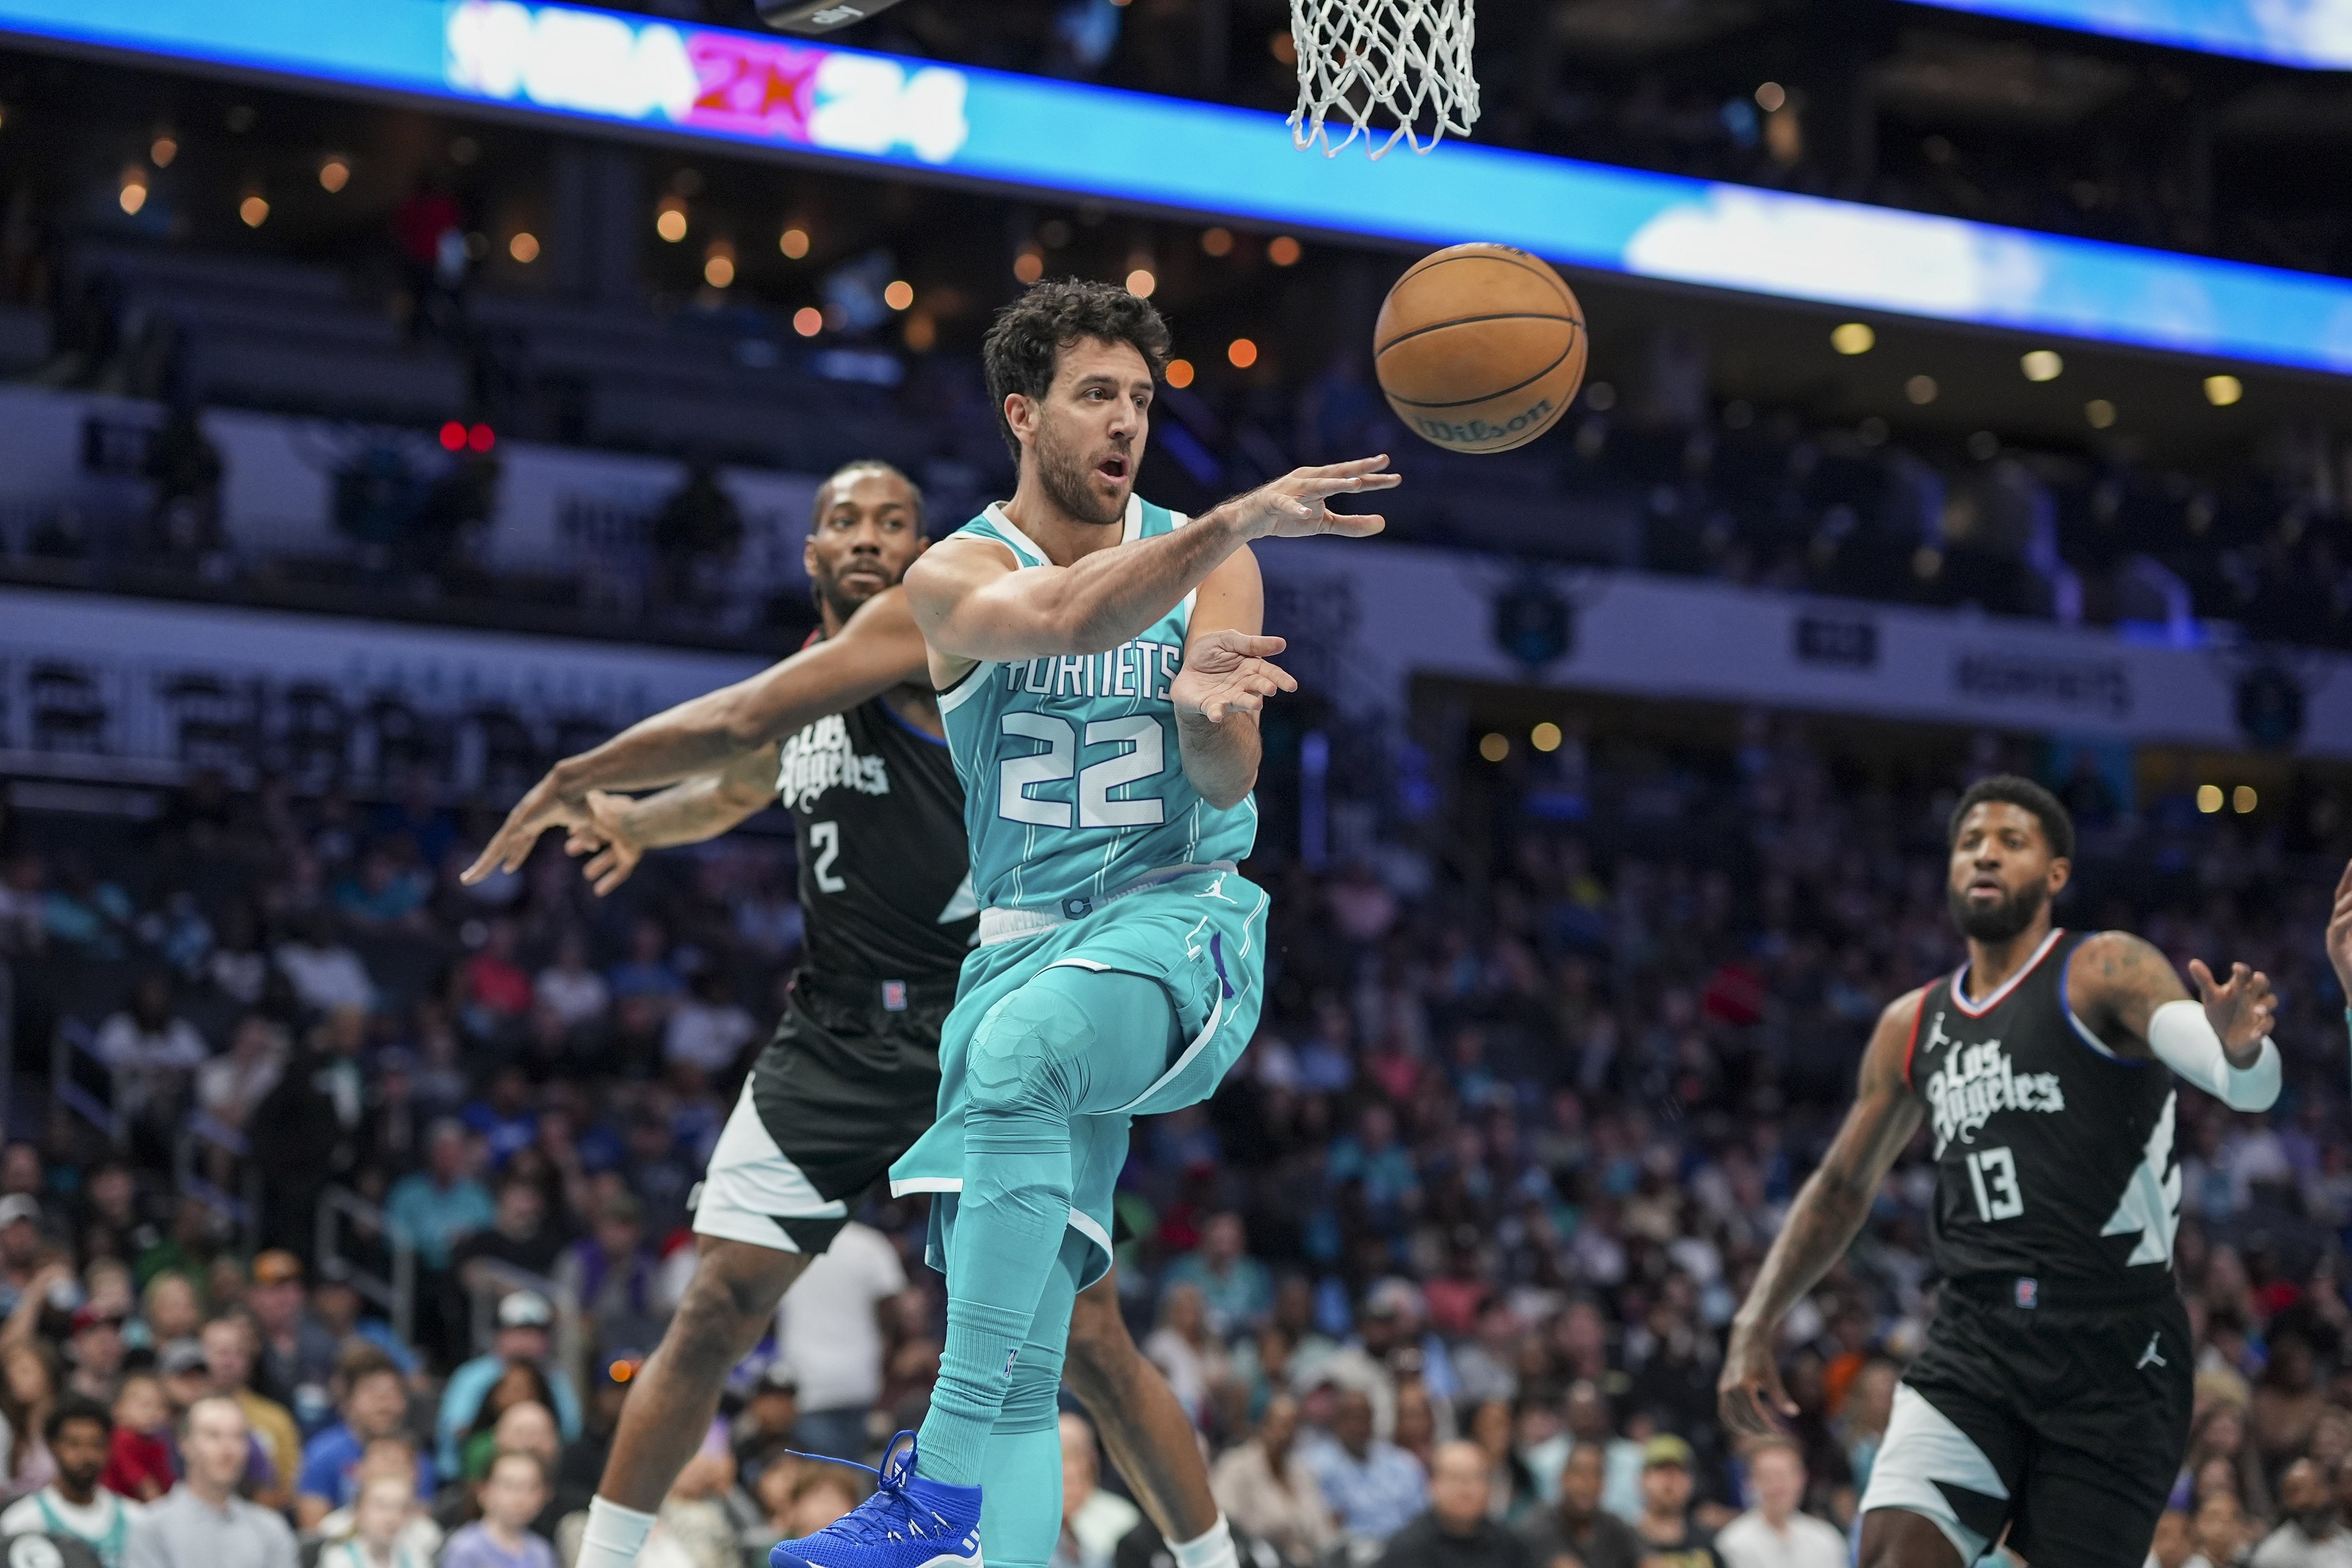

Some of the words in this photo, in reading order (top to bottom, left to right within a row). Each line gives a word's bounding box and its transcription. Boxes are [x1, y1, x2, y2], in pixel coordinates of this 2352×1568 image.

[1413, 399, 1553, 443] Wilson
[999, 712, 1165, 829] 22
[809, 820, 846, 894] 2
[1945, 1038, 2003, 1088] Los
[1925, 1053, 2066, 1162] Angeles
[1966, 1145, 2025, 1223] 13
